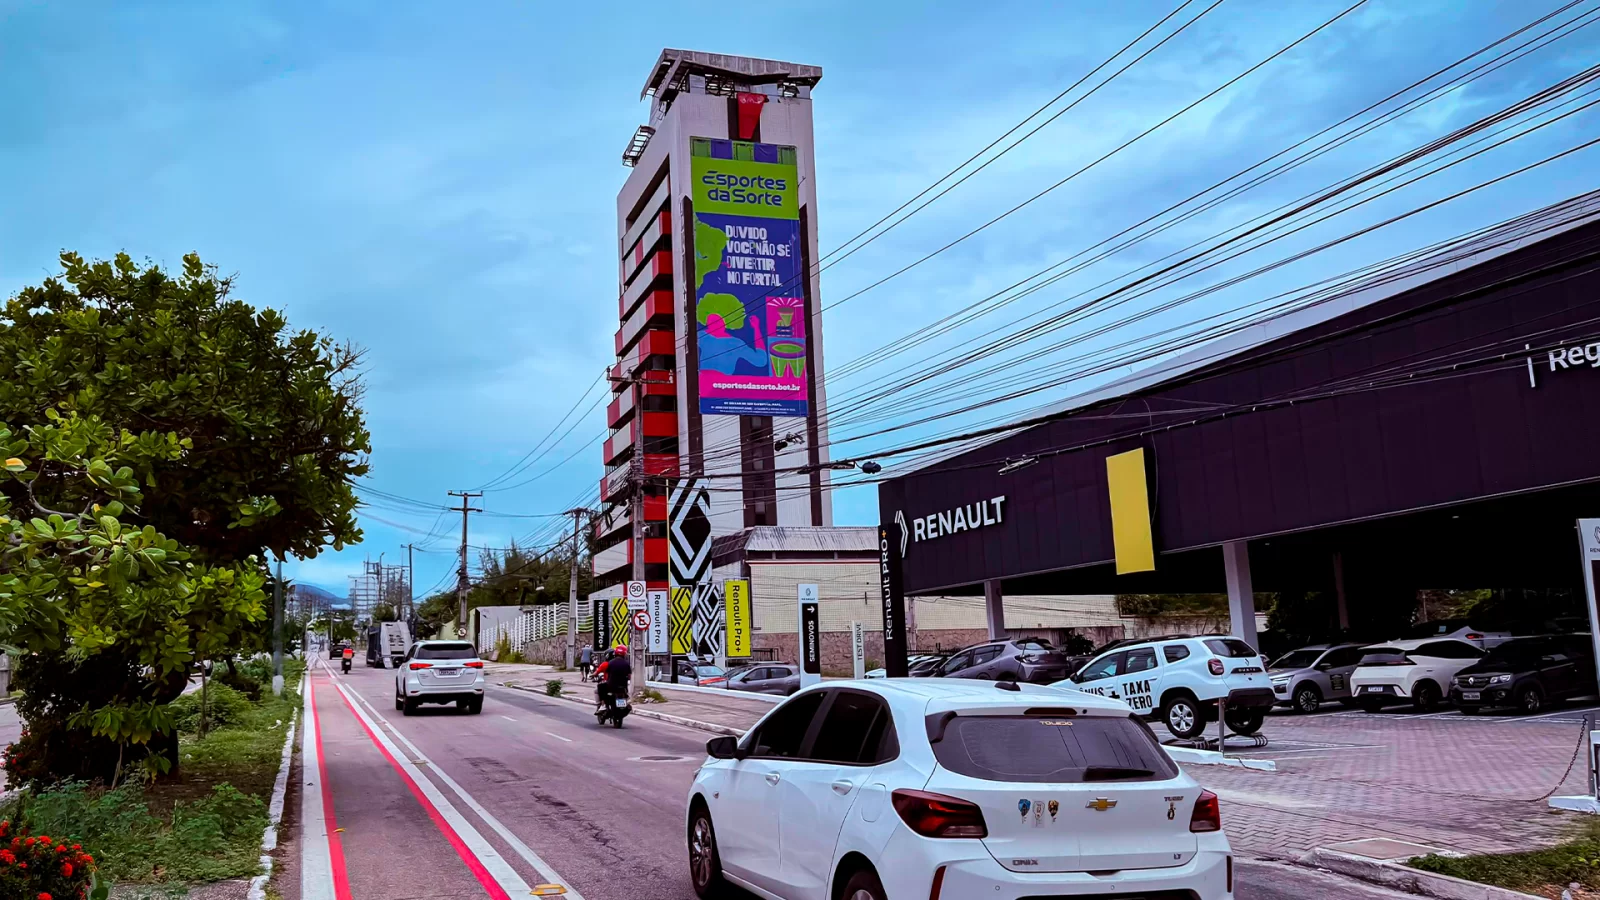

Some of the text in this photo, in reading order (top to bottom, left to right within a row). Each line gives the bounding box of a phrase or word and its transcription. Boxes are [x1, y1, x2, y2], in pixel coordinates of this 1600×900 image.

[702, 170, 786, 190] Esportes
[725, 225, 767, 240] DUVIDO
[756, 241, 776, 256] NÃO
[777, 244, 791, 257] SE
[726, 256, 776, 271] DIVERTIR
[727, 271, 782, 287] NO FORTAL
[1548, 342, 1600, 372] Reg
[913, 495, 1005, 542] RENAULT
[631, 585, 642, 593] 50
[880, 530, 894, 640] Renault PRO+
[732, 585, 742, 653] Renault Pro+
[808, 620, 816, 662] SEMINOVOS
[1122, 680, 1151, 696] TAXA
